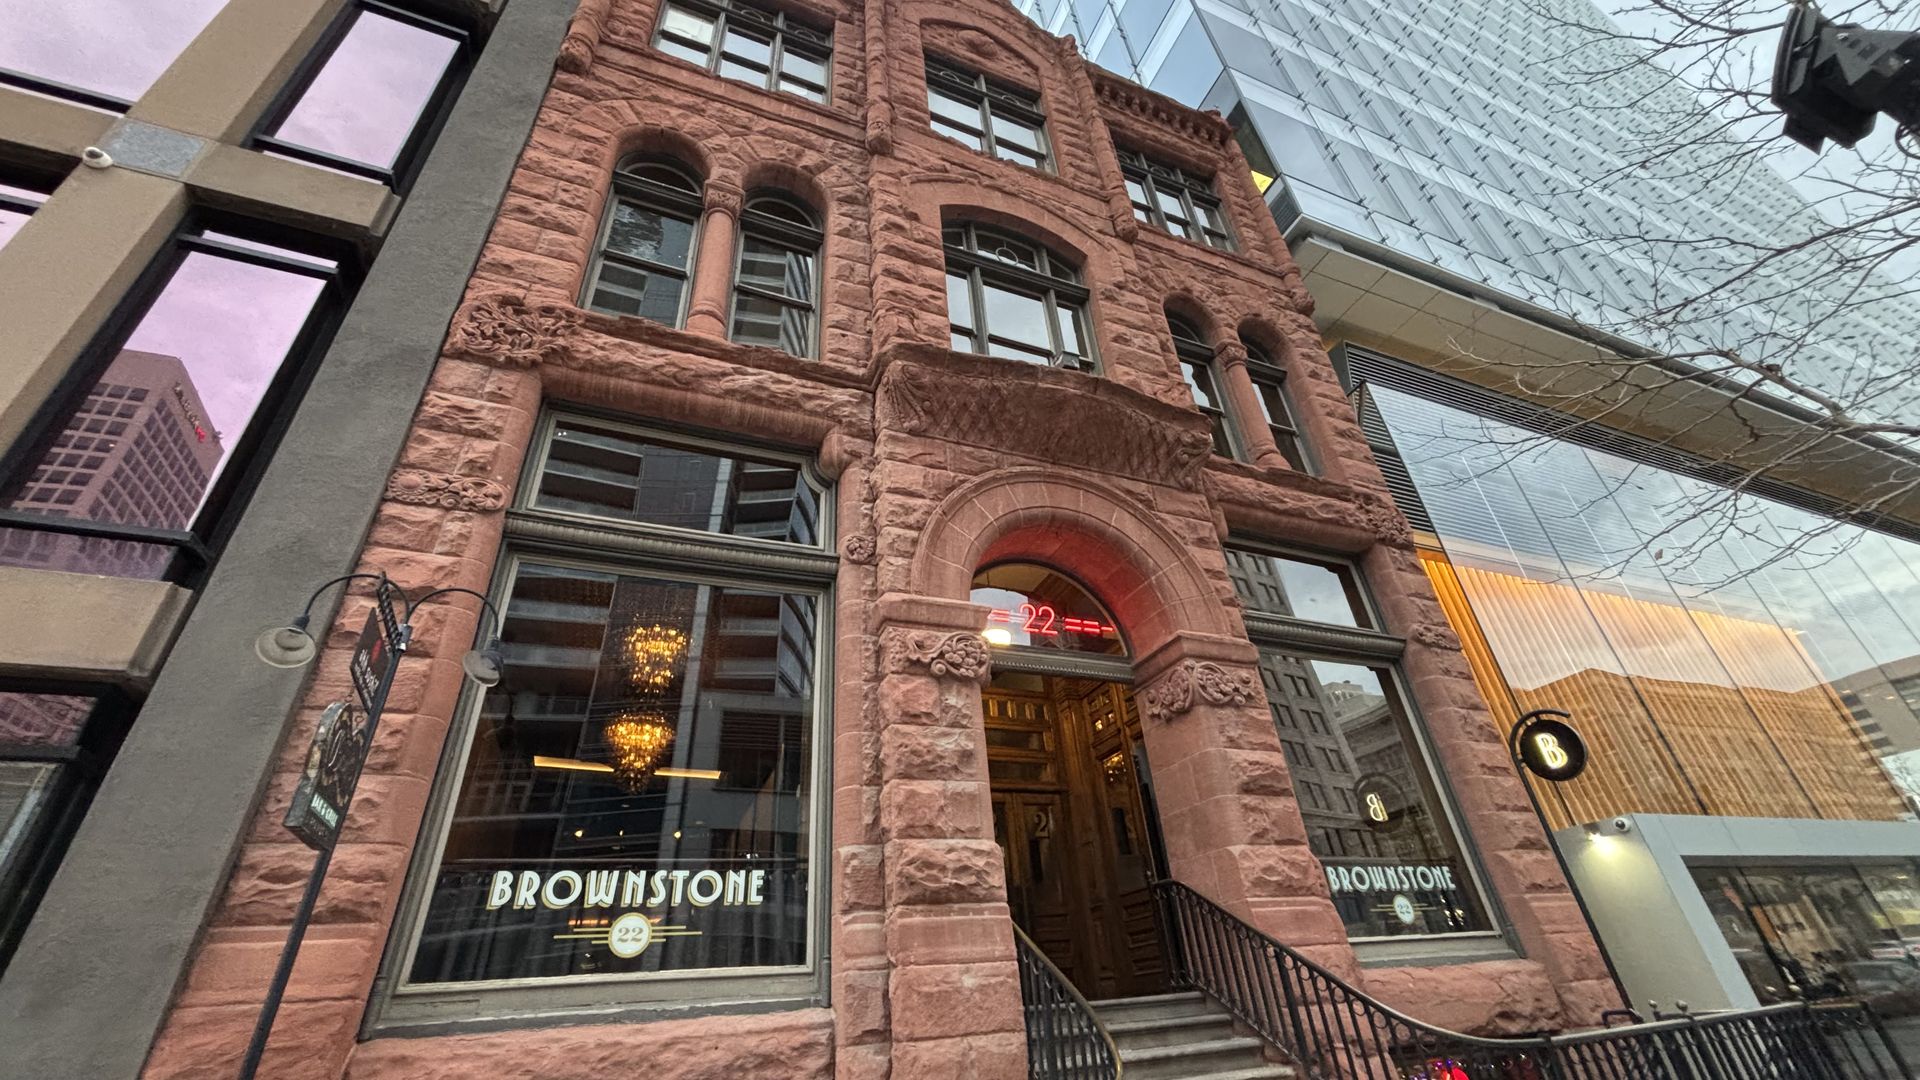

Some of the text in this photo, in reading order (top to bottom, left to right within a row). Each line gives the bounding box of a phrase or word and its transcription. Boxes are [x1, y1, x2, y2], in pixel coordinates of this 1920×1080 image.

[1020, 603, 1058, 634] 22
[1534, 732, 1568, 769] B
[486, 869, 764, 910] BROWNSTONE
[1326, 866, 1456, 892] BROWNSTONE
[617, 926, 644, 943] 22
